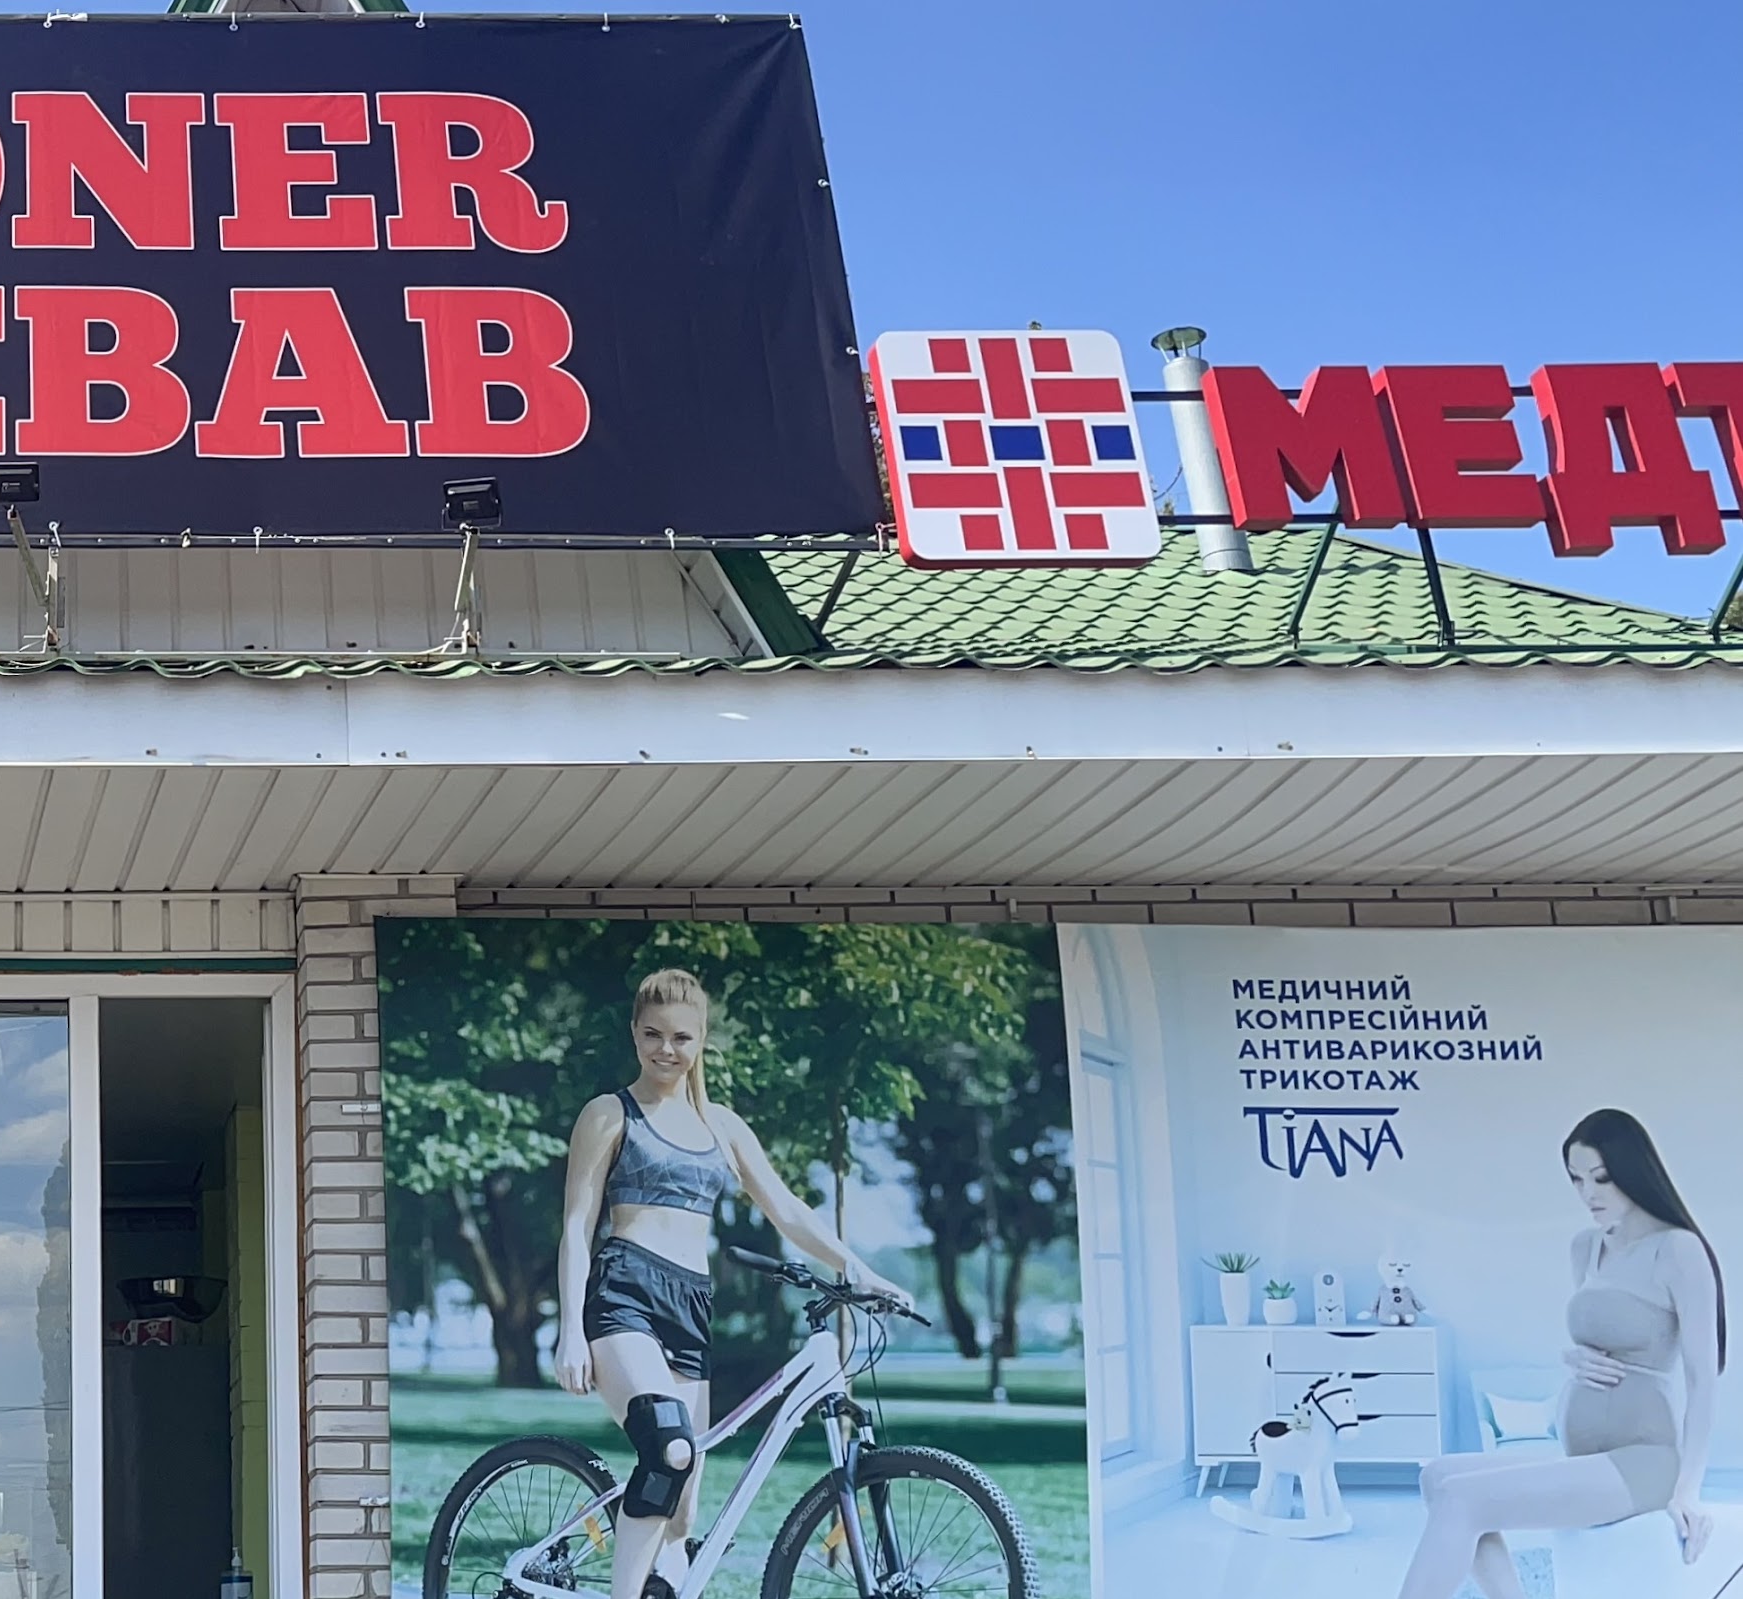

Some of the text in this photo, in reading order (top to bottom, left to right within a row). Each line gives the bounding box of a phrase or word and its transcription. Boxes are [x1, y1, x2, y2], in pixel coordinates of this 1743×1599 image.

[1231, 975, 1411, 1003] МЕДИЧНИЙ
[1235, 1005, 1488, 1031] КОМПРЕСІЙНИЙ
[1238, 1035, 1544, 1062] АНТИВАРИКОЗНИЙ
[1239, 1069, 1421, 1091] ТРИКОТАЖ
